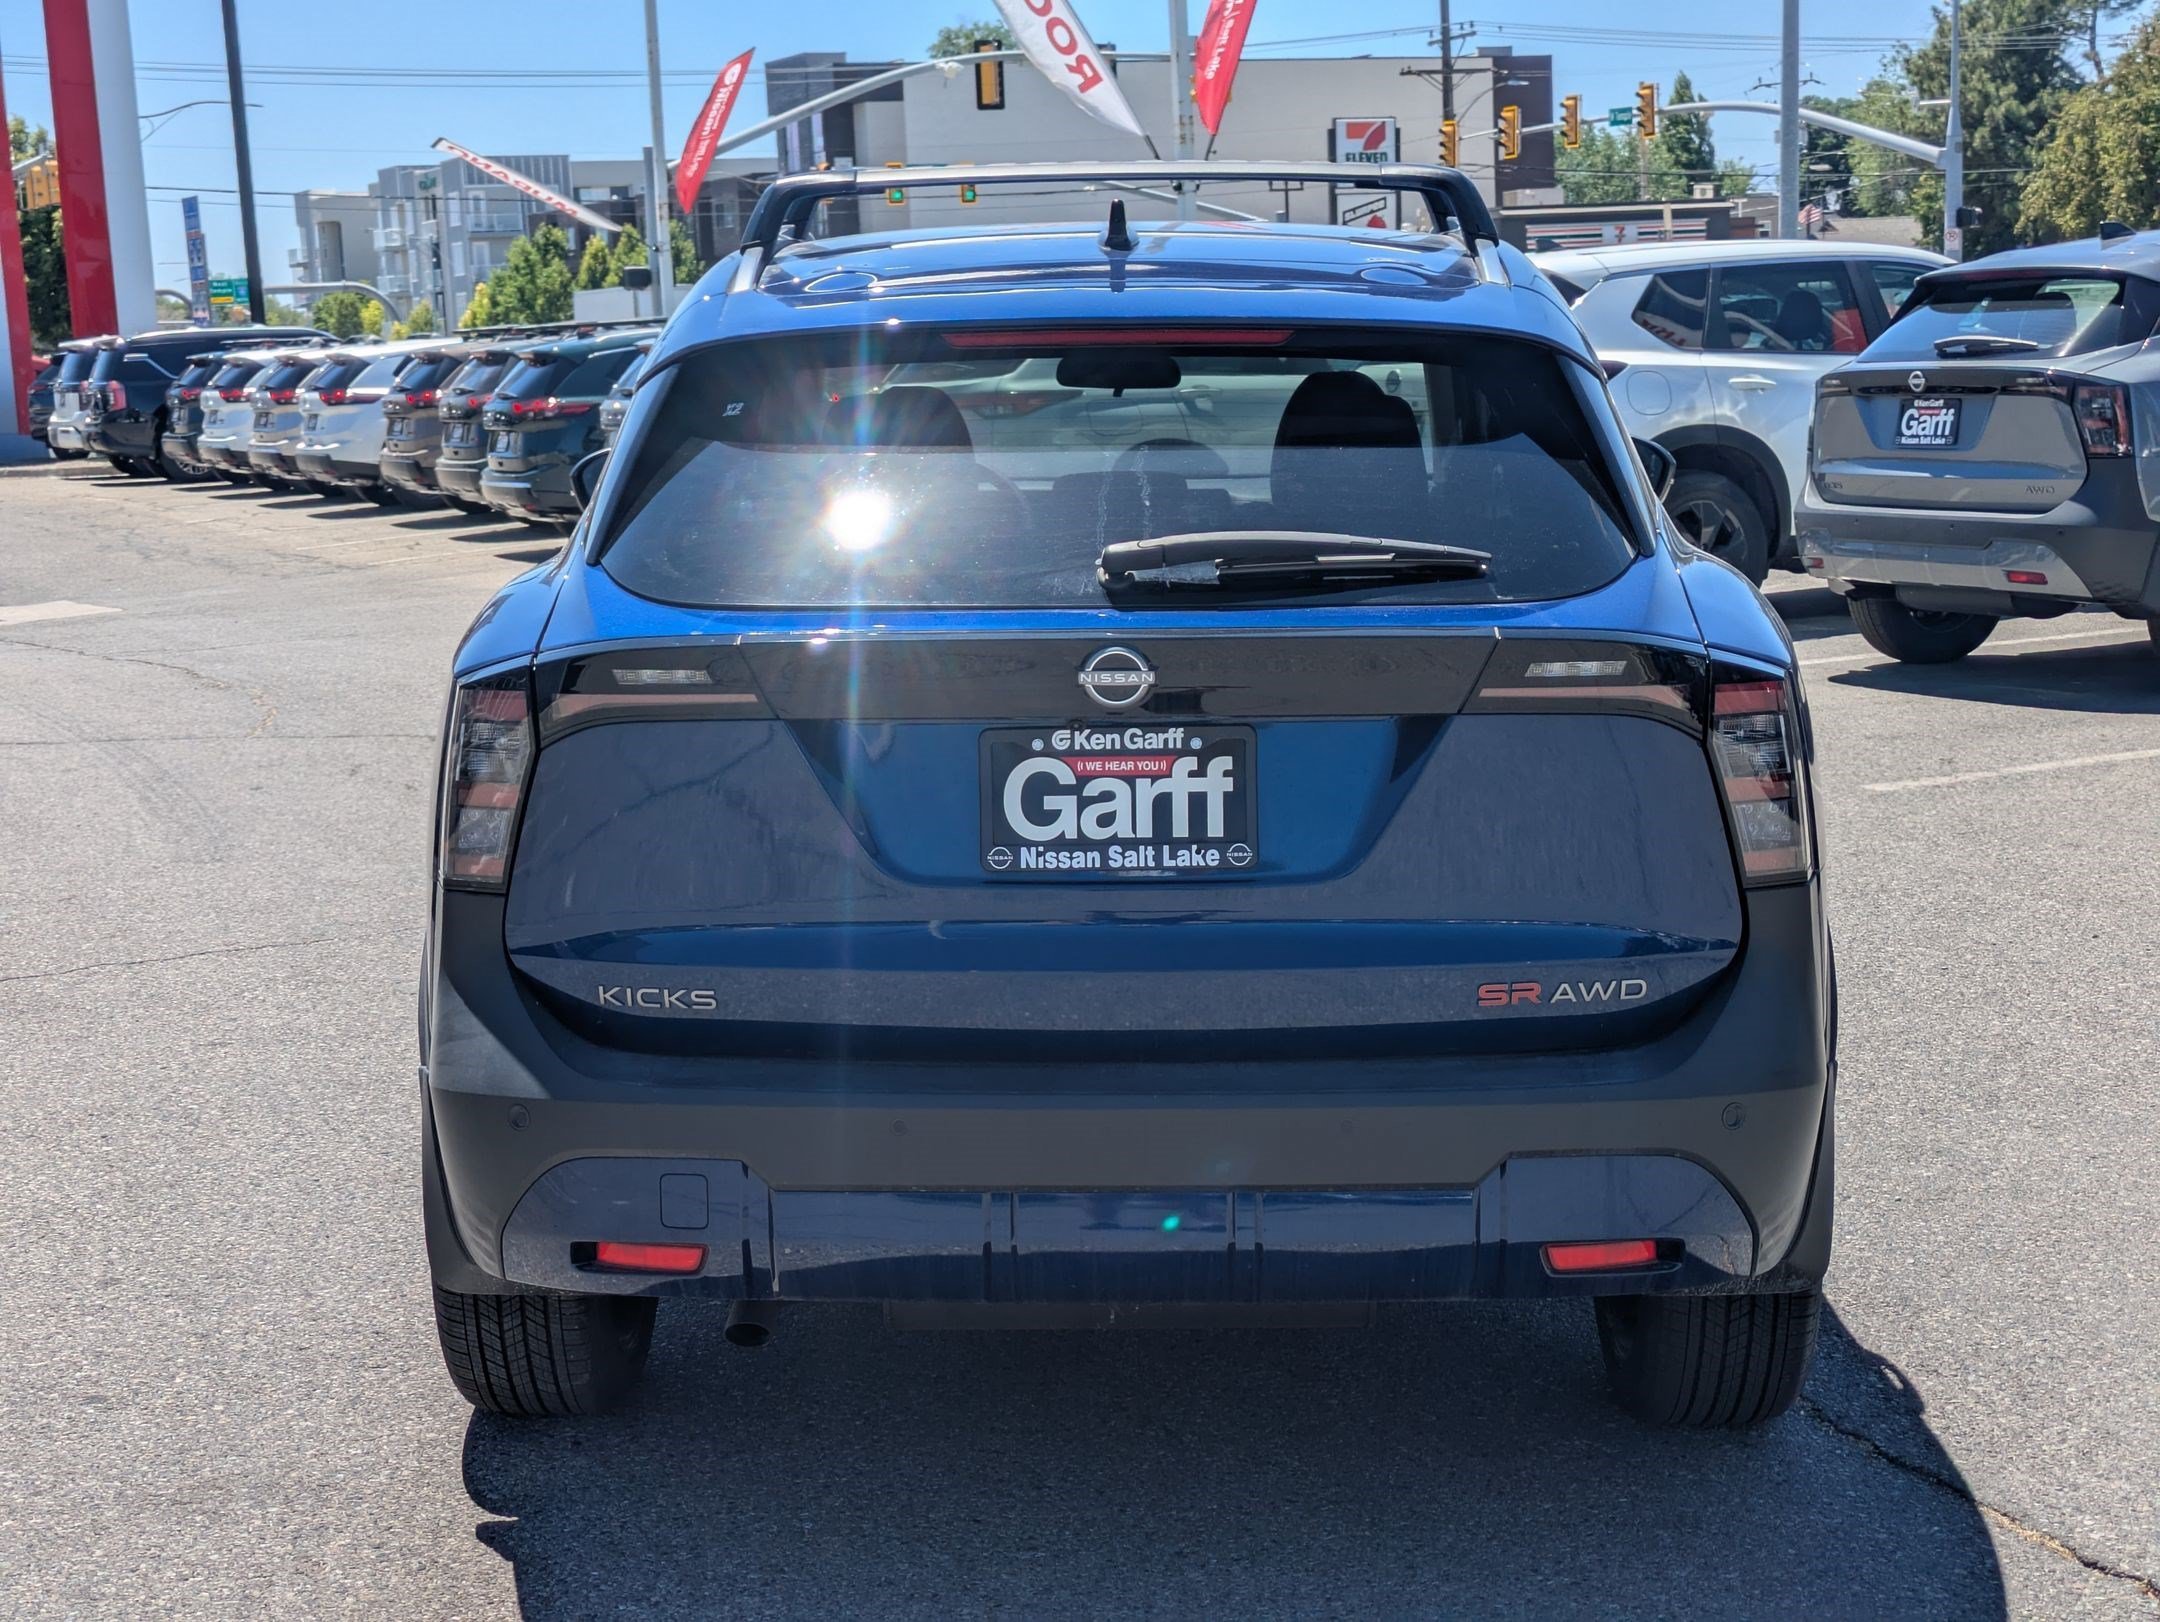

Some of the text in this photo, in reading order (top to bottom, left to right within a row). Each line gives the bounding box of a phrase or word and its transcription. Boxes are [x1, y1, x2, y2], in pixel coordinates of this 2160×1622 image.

[1901, 408, 1955, 436] Garff
[1080, 672, 1154, 683] NISSAN
[1073, 728, 1184, 750] Ken Garff
[1085, 761, 1160, 772] WE HEAR YOU
[1003, 755, 1234, 842] Garff
[1020, 844, 1220, 869] Nissan Salt Lake
[598, 985, 717, 1010] KICKS
[1478, 979, 1648, 1007] SR AWD
